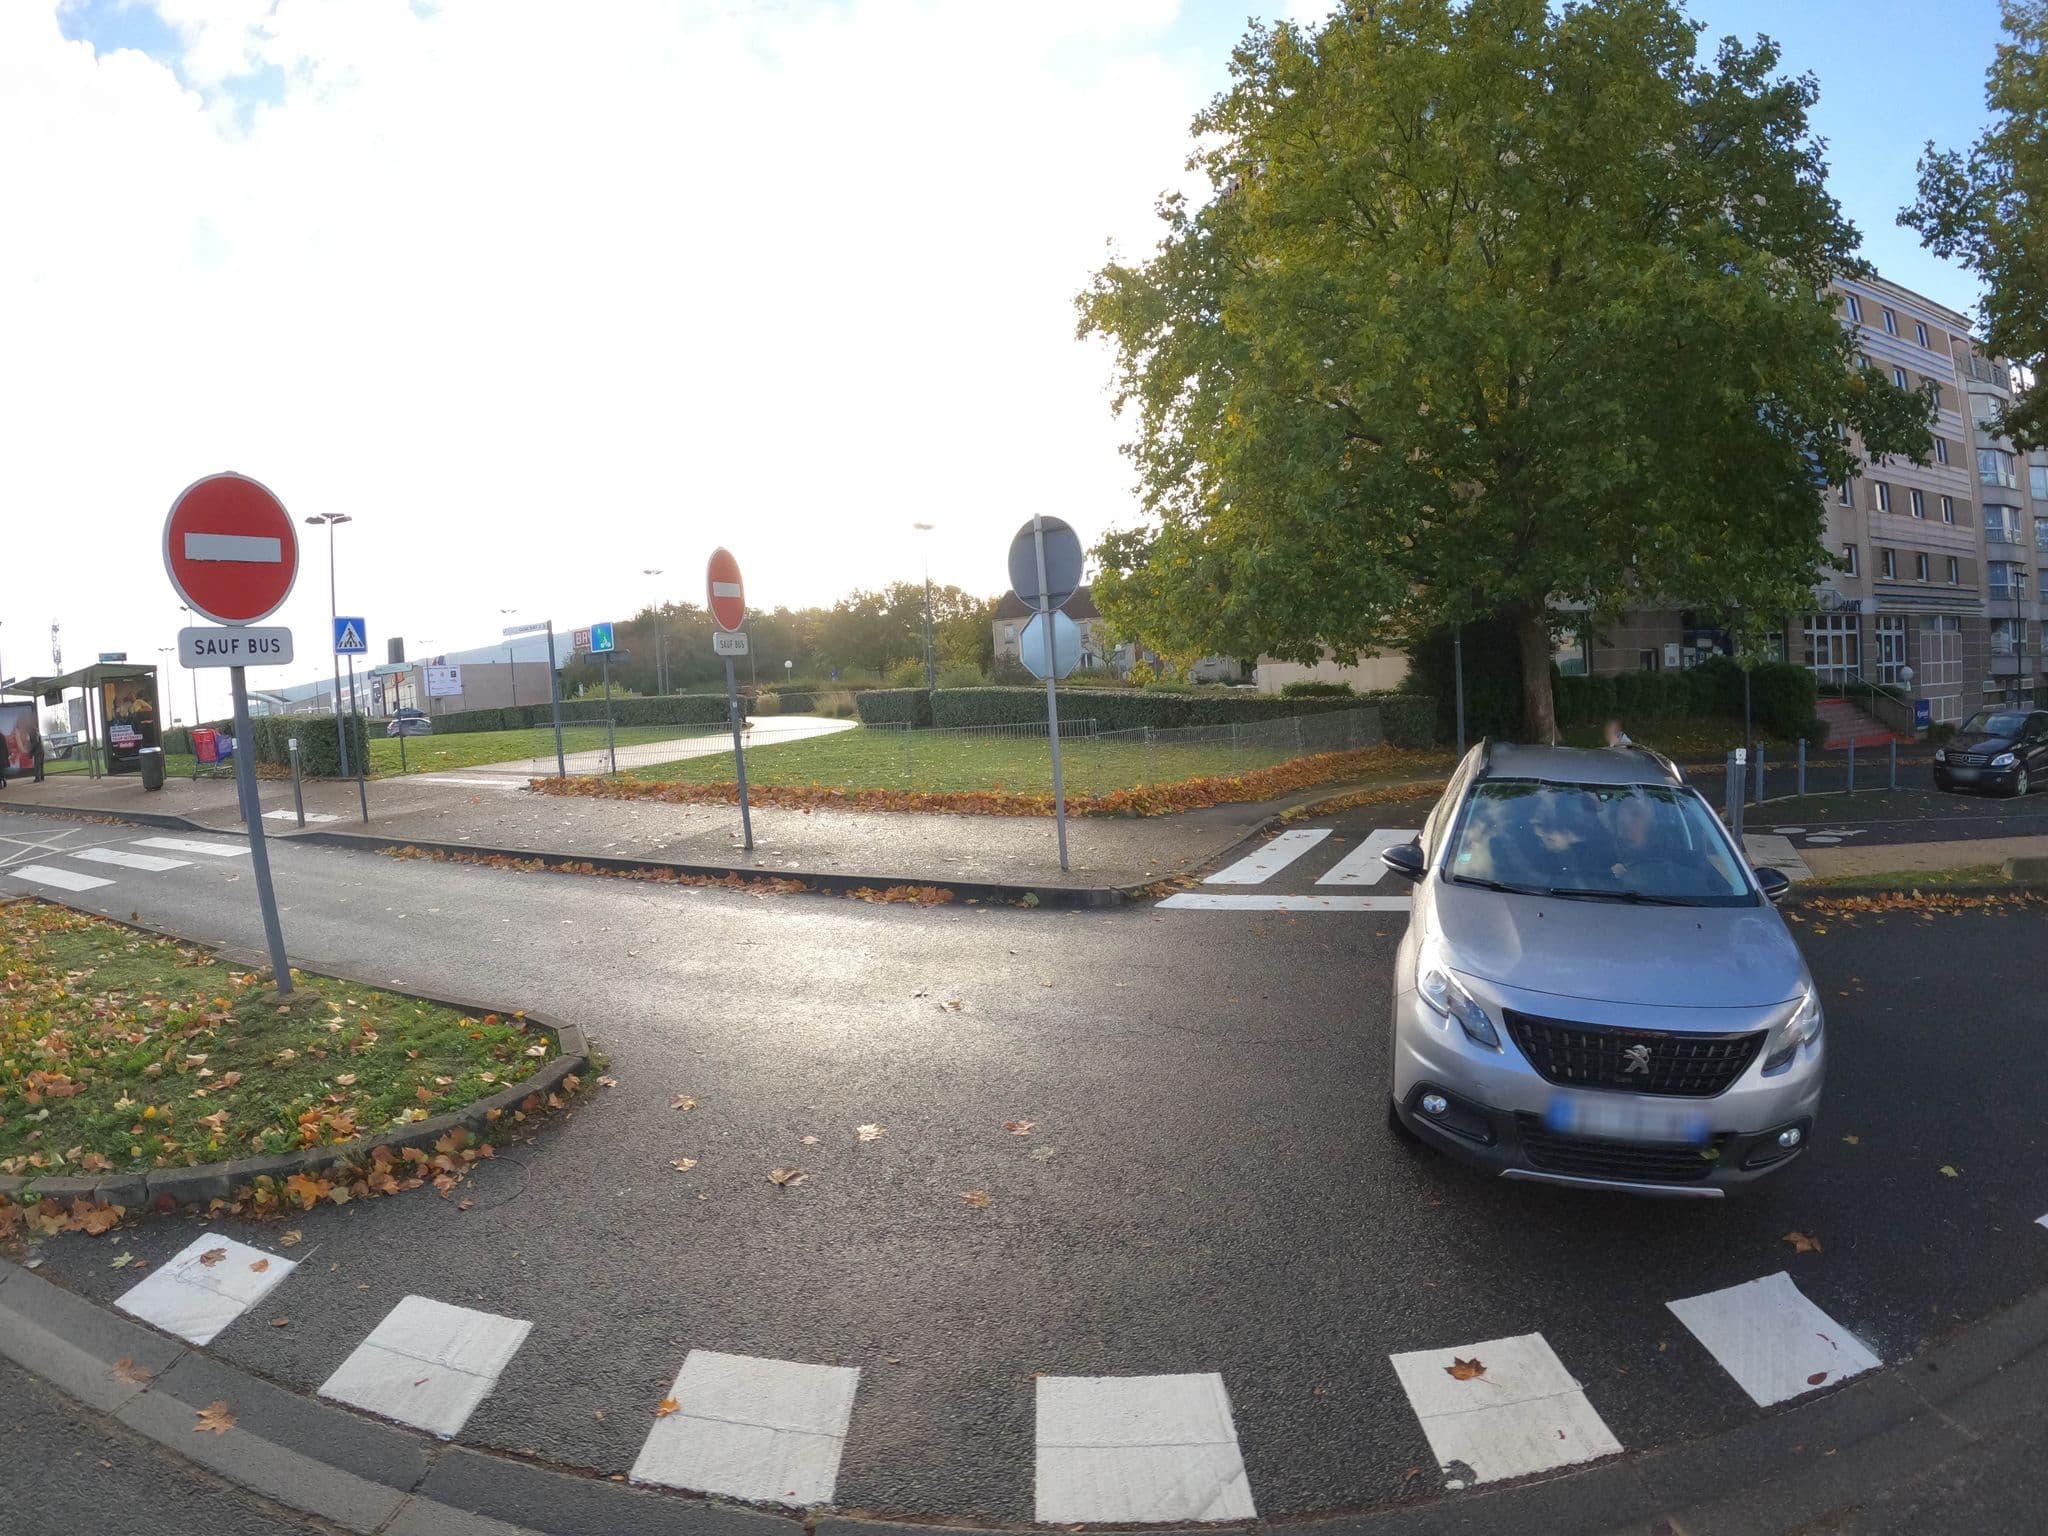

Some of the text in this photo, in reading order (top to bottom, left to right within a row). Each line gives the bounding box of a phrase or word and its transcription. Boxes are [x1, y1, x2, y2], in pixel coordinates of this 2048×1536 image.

[575, 631, 590, 646] BA
[720, 639, 745, 649] SAUF BUS
[194, 638, 281, 655] SAUF BUS
